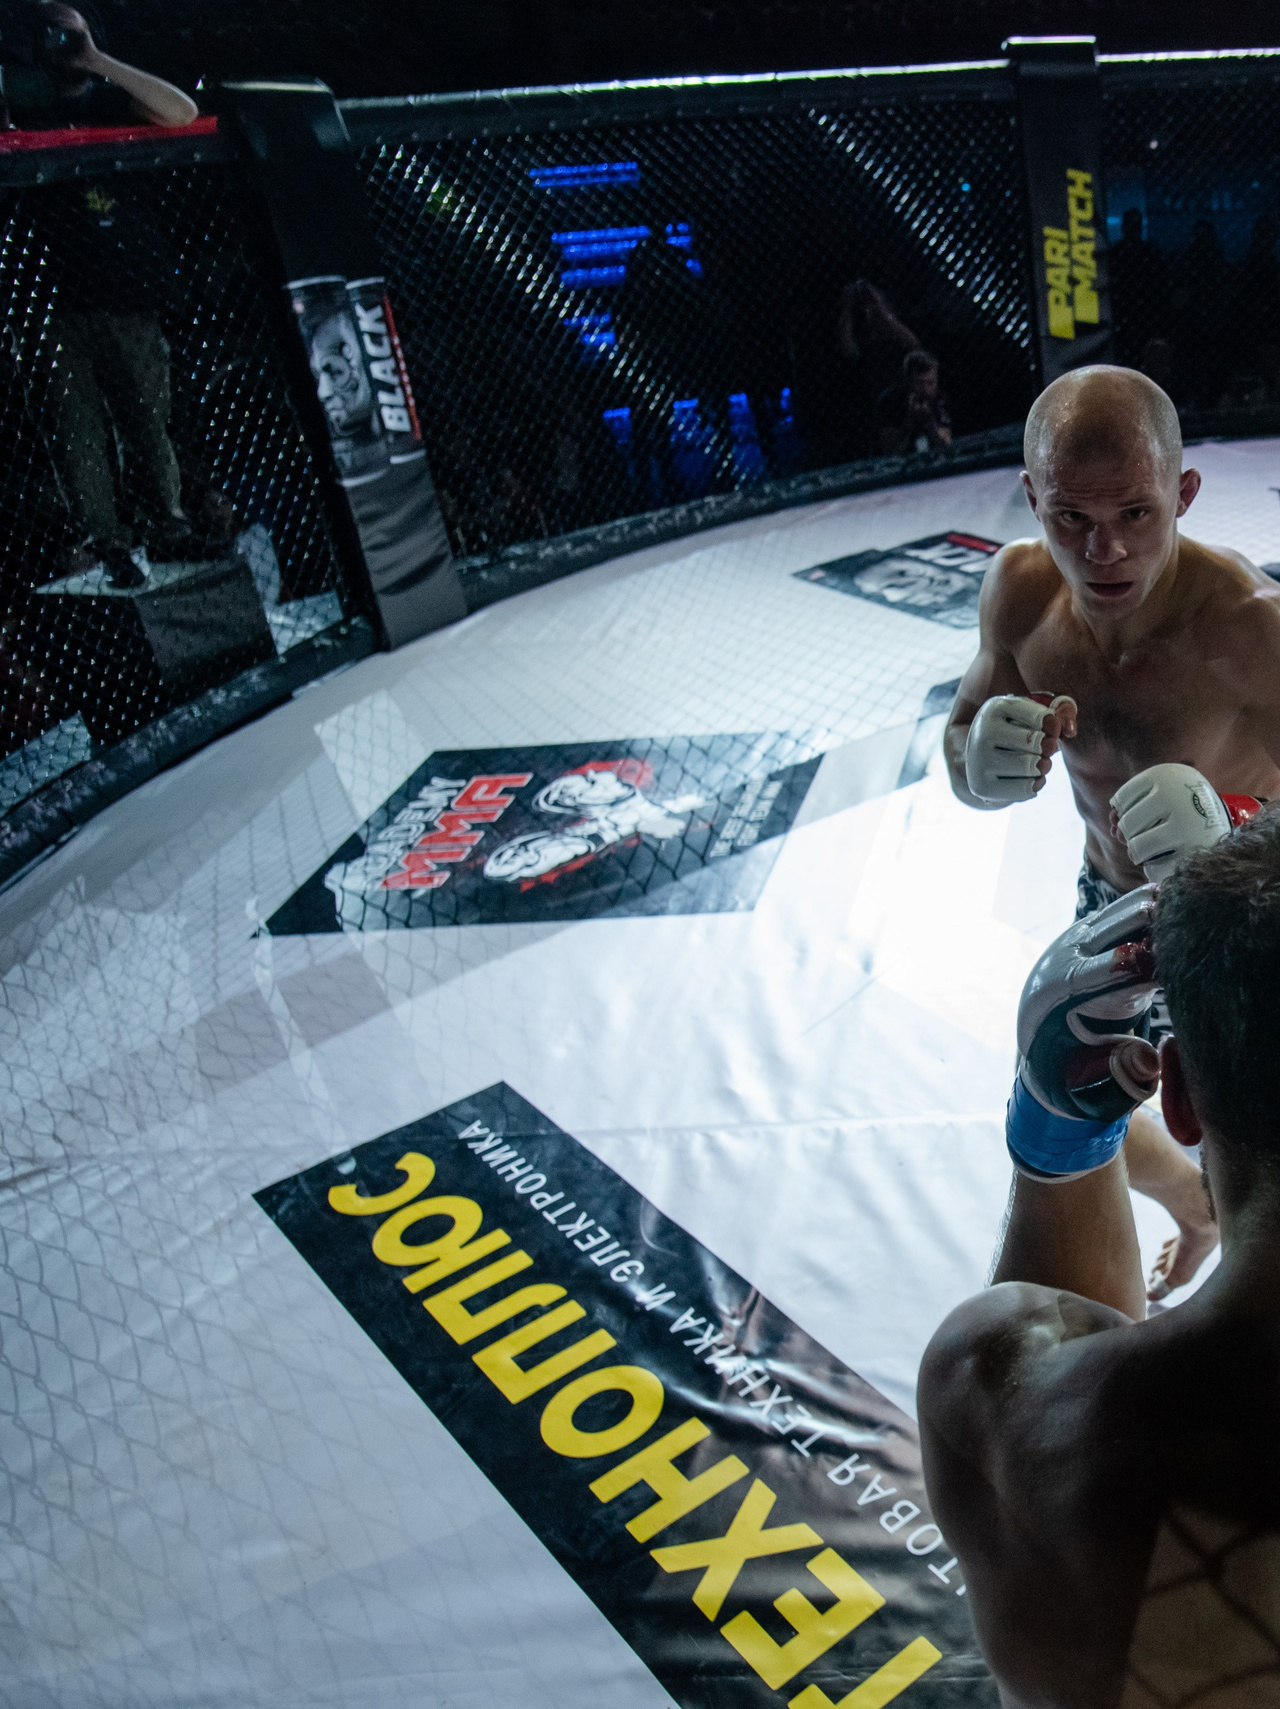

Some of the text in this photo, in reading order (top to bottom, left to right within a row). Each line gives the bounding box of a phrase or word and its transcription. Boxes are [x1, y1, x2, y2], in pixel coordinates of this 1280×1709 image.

[1042, 226, 1076, 341] PARI
[1066, 167, 1100, 325] MATCH
[354, 302, 413, 434] BLACK
[379, 772, 533, 890] MMA
[458, 1118, 646, 1287] ЭЛЕКТРОНИКА
[827, 1453, 967, 1597] ТОВАЯ
